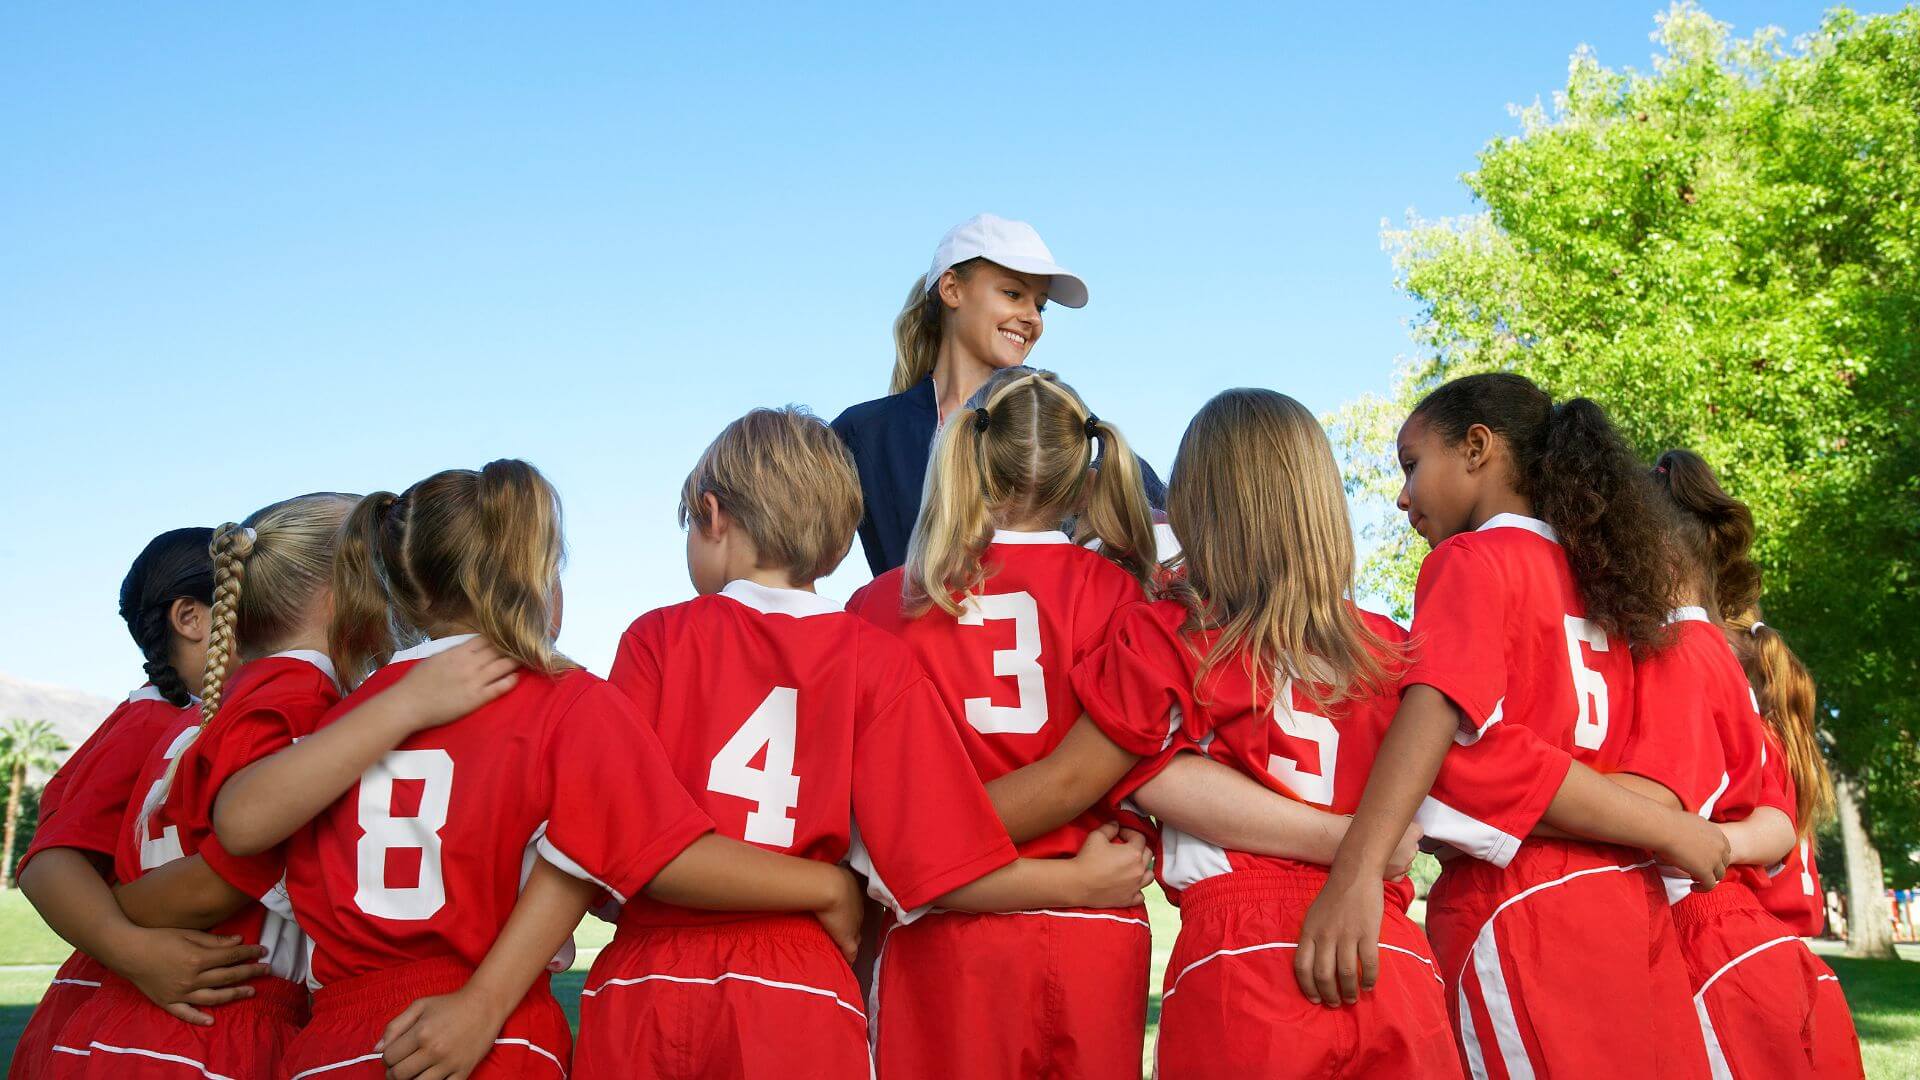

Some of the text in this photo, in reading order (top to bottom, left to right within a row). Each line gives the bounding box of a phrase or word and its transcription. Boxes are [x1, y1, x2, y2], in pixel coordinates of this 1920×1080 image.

[958, 591, 1049, 734] 3
[1267, 649, 1340, 806] 5
[1563, 613, 1609, 751] 6
[354, 749, 455, 921] 8
[706, 686, 801, 848] 4
